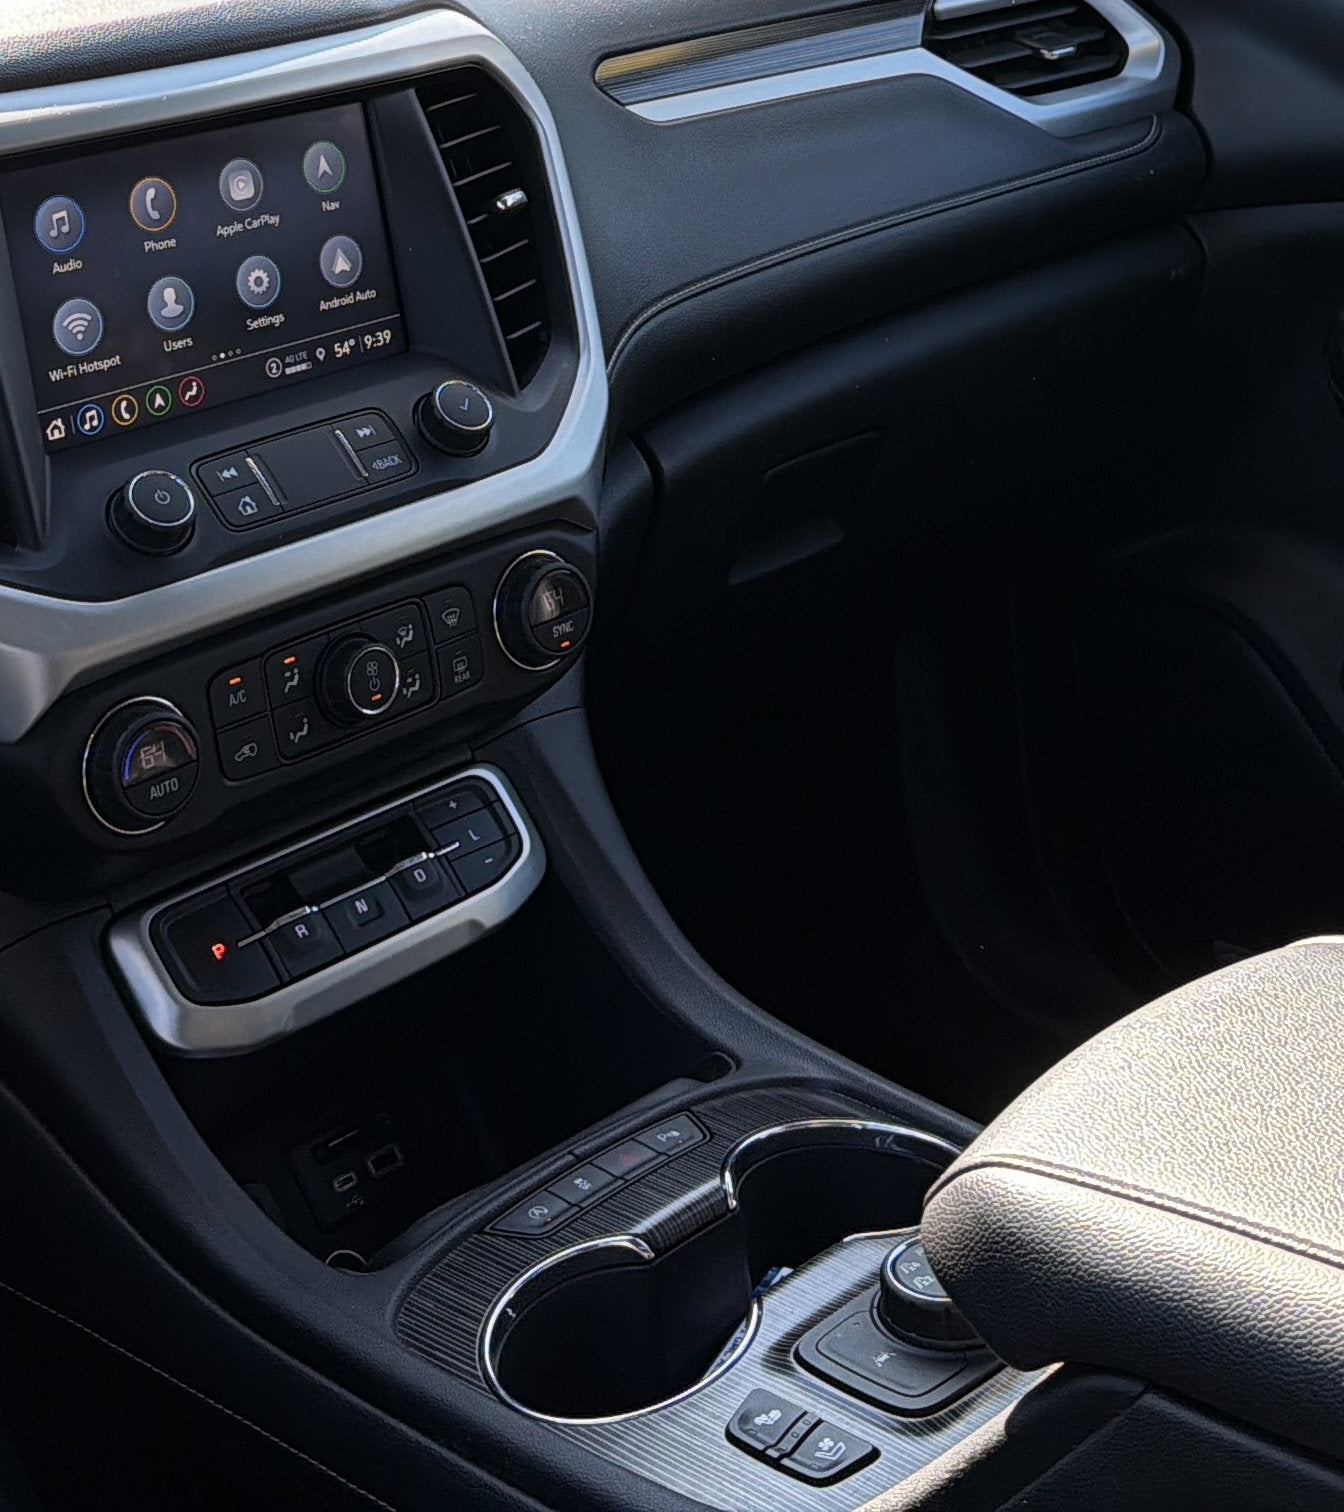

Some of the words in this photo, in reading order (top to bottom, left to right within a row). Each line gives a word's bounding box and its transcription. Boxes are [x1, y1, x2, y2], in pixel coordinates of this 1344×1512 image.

[321, 199, 340, 211] Nav
[216, 221, 244, 238] Apple
[244, 213, 280, 232] CarPlay
[144, 236, 177, 253] Phone
[52, 258, 83, 275] Audio
[319, 293, 354, 312] Android
[354, 288, 377, 305] Auto
[246, 311, 285, 332] Settings
[163, 336, 193, 352] Users
[364, 329, 392, 349] 9:39
[285, 353, 295, 363] 4G
[296, 350, 308, 361] LTE
[333, 338, 356, 359] 54°
[48, 366, 77, 384] Wi-Fi
[78, 354, 122, 379] Hotspot
[376, 454, 402, 470] BACK
[552, 619, 574, 638] SYNC
[229, 690, 247, 707] A/C
[140, 740, 167, 769] 64
[150, 777, 179, 800] AUTO
[468, 829, 480, 842] L
[414, 868, 427, 883] D
[355, 898, 368, 914] N
[294, 924, 309, 939] R
[212, 942, 226, 961] P
